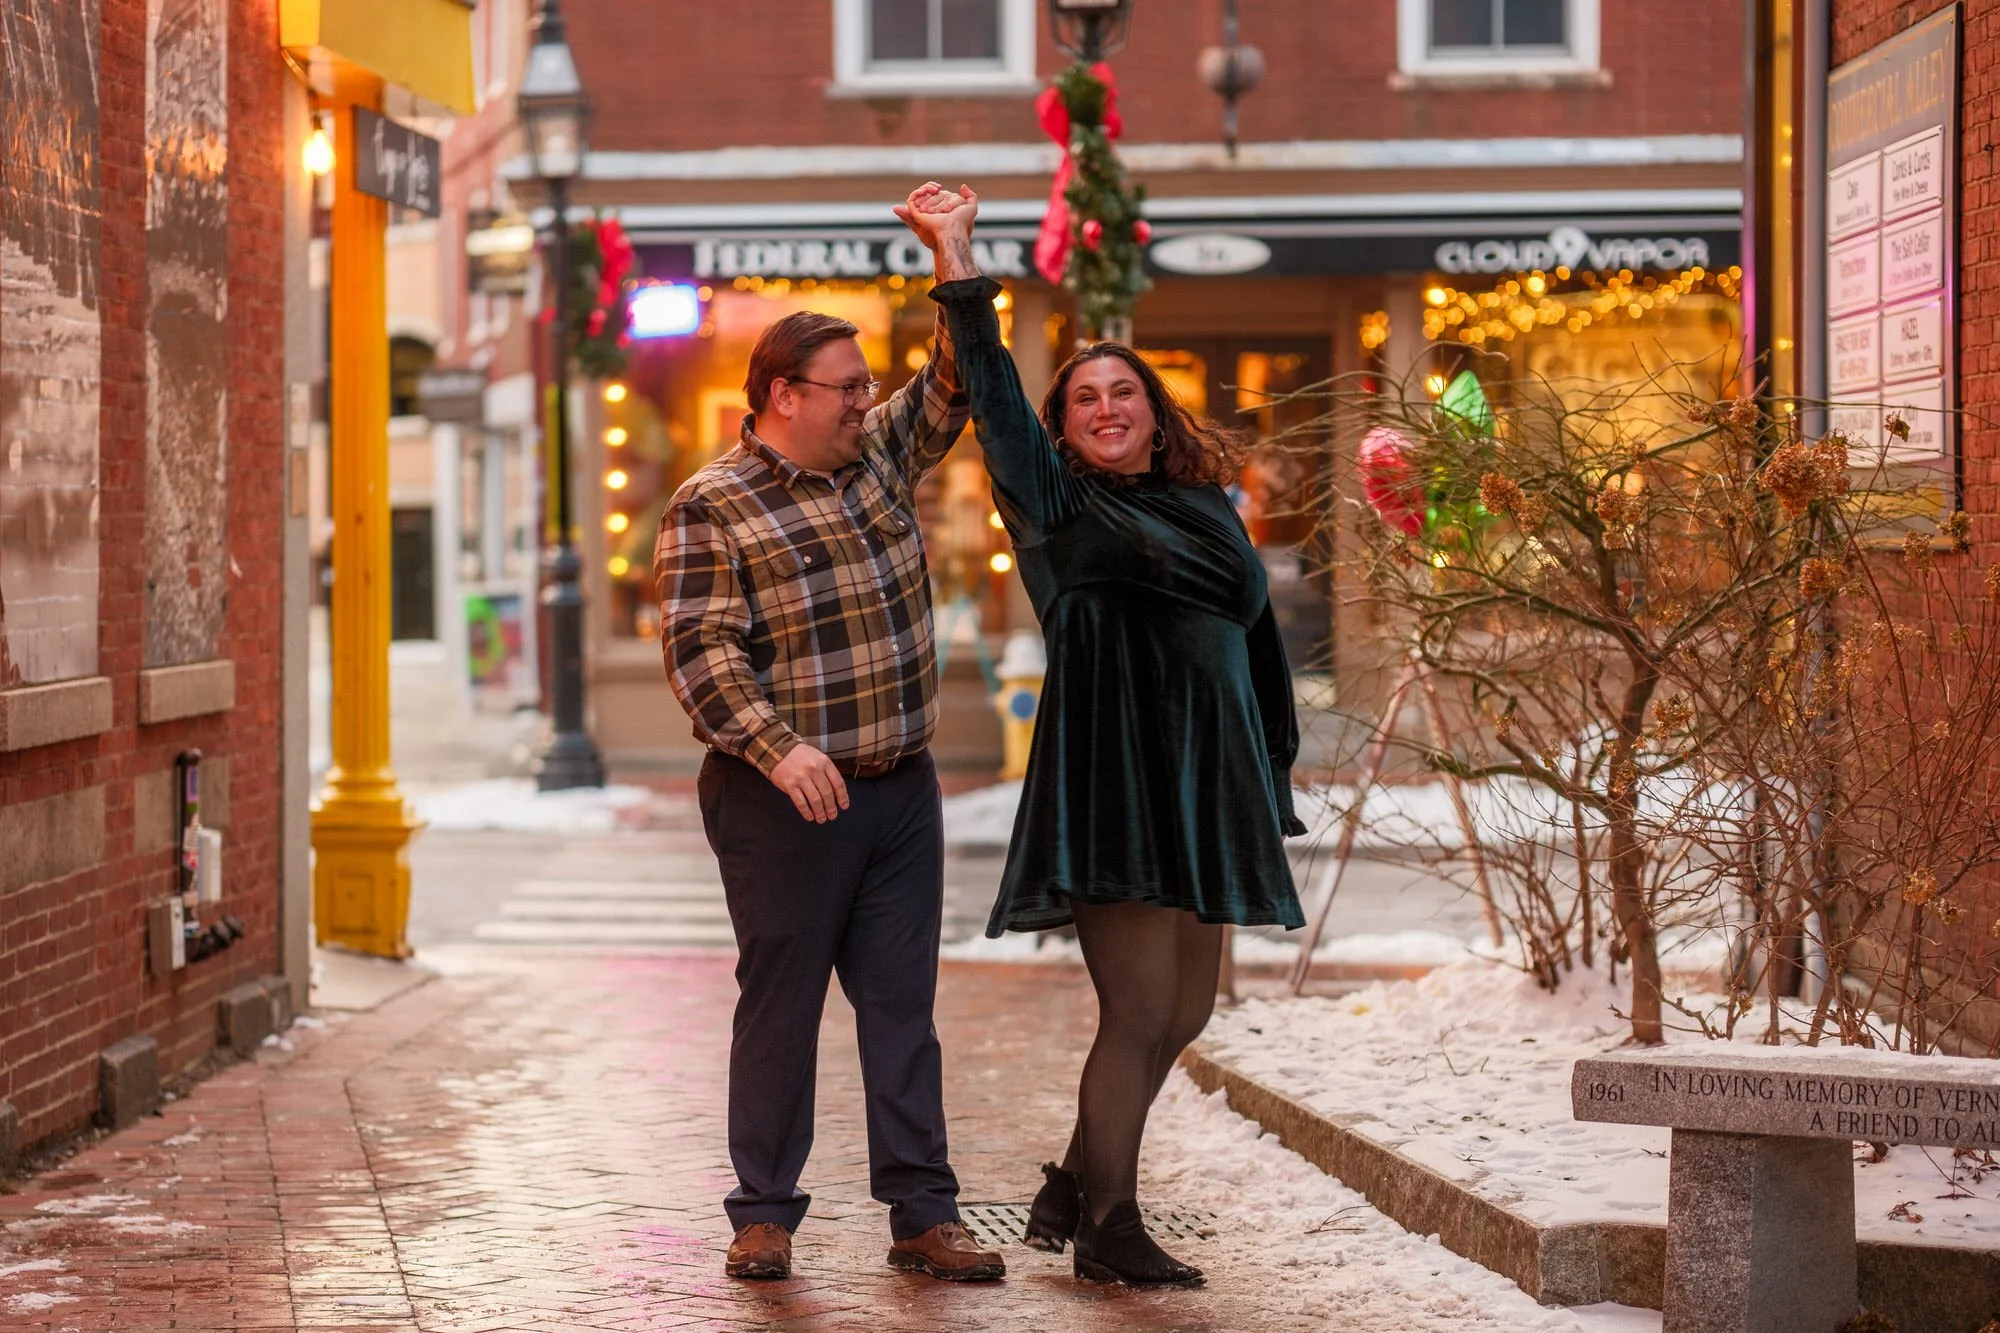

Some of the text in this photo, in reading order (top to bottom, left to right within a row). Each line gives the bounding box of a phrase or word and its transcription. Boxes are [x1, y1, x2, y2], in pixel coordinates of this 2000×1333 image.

[1906, 35, 1949, 119] ALLEY
[693, 236, 1028, 278] FEDERAL CAR
[1435, 225, 1711, 274] CLOUD 9 VAPOR
[1589, 1082, 1625, 1102] 1961
[1654, 1071, 2000, 1114] IN LOVING MEMORY OF VERN
[1809, 1111, 2000, 1144] A FRIEND TO AL
